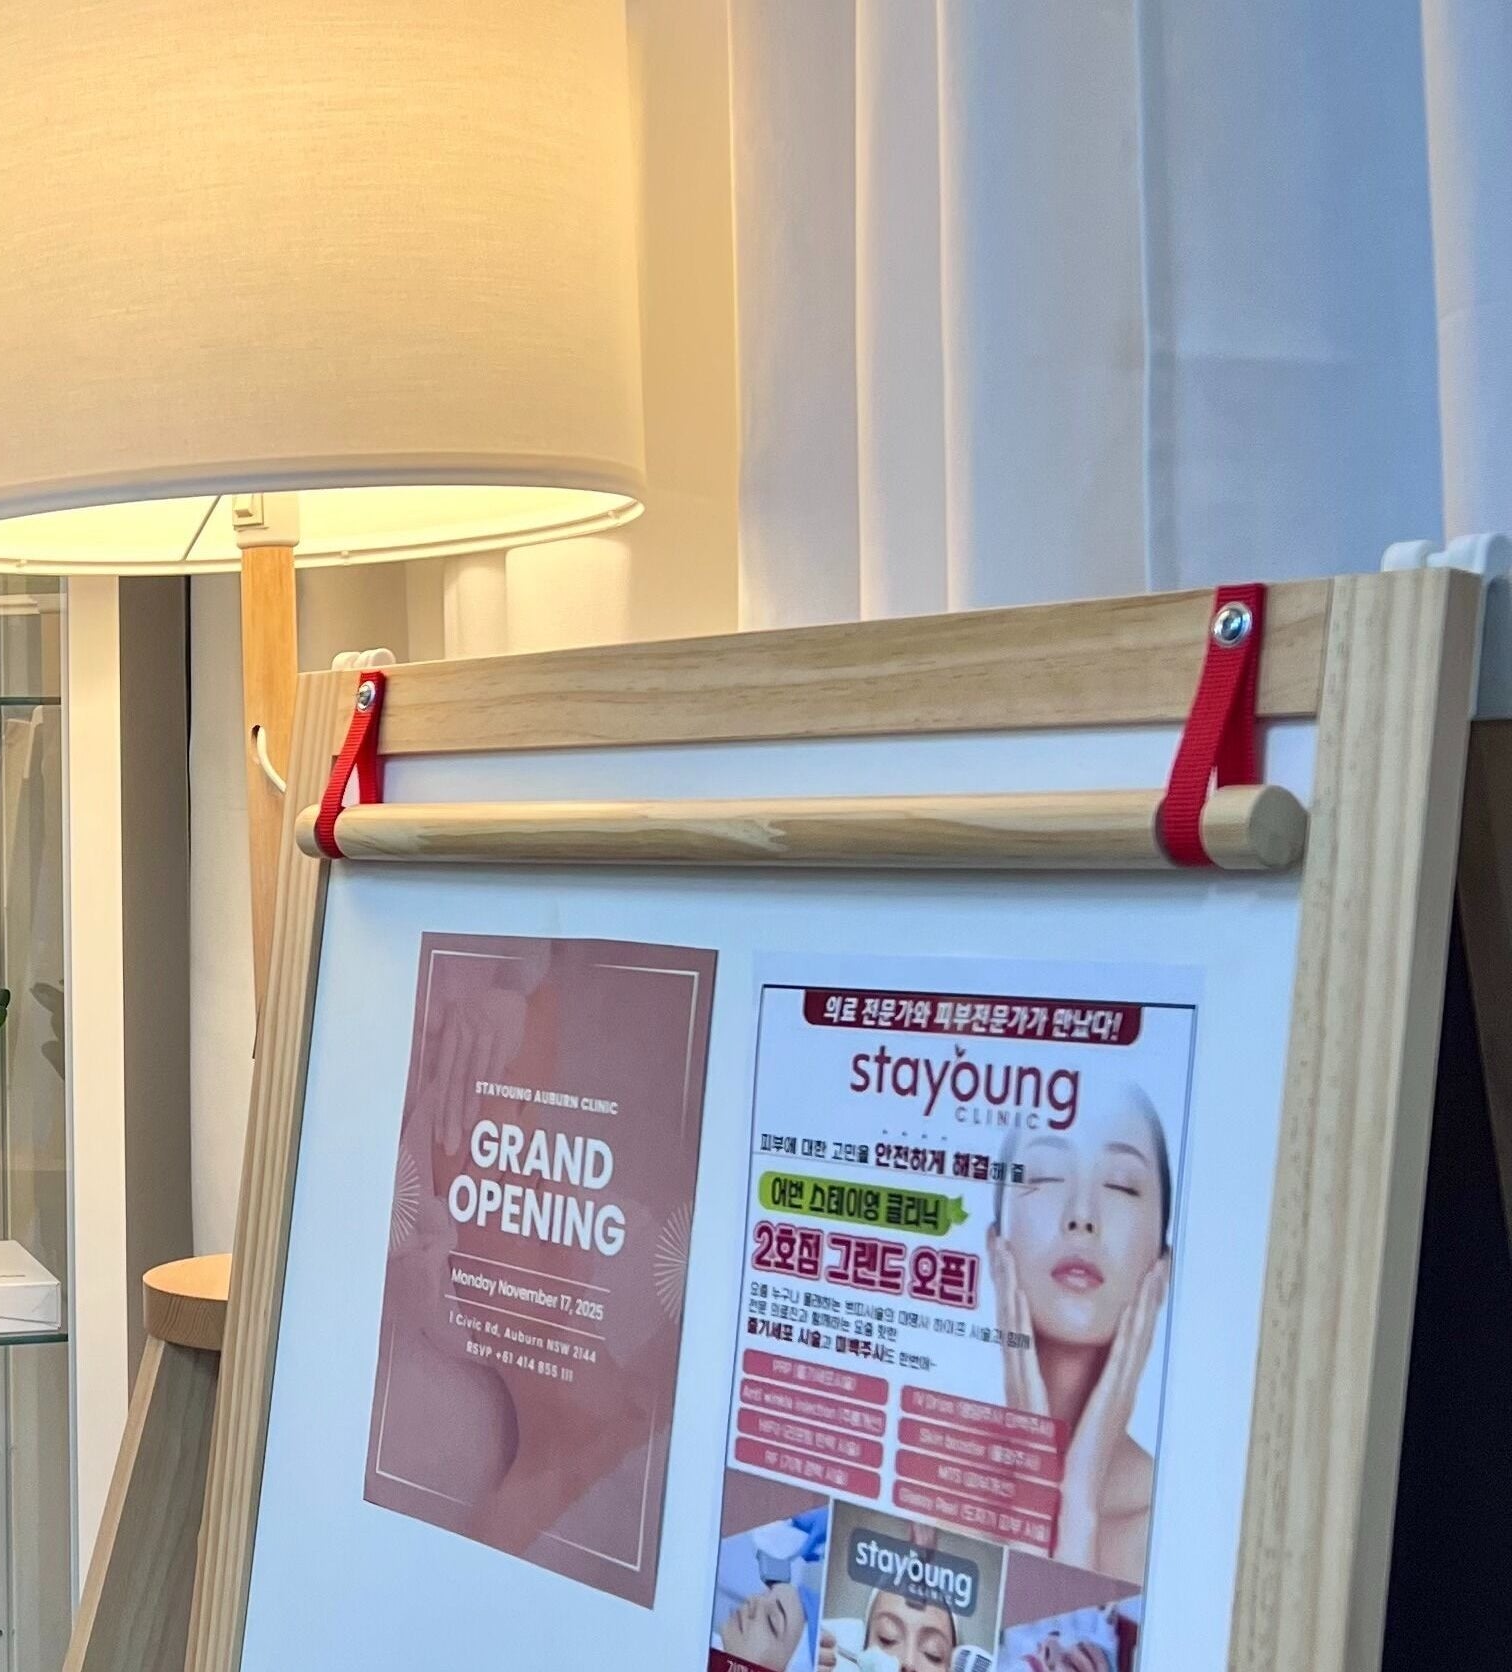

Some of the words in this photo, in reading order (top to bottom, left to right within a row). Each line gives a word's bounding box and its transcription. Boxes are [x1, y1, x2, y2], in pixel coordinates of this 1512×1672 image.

[824, 996, 859, 1023] 의료
[862, 998, 931, 1028] 전문가와
[475, 1081, 532, 1101] STAYOUNG
[534, 1090, 579, 1109] AUBURN
[580, 1098, 619, 1115] CLINIC
[850, 1045, 1080, 1130] stayoung
[955, 1107, 1040, 1129] CLINIC
[471, 1119, 614, 1190] GRAND
[875, 1142, 945, 1175] 안전하게
[448, 1174, 625, 1256] OPENING
[771, 1177, 803, 1209] 어번
[810, 1184, 881, 1221] 스테이영
[753, 1221, 823, 1278] 2호점
[910, 1247, 979, 1307] 오픈!
[451, 1267, 496, 1296] Monday
[498, 1280, 558, 1308] November
[560, 1294, 574, 1315] 17,
[576, 1299, 604, 1321] 2025
[456, 1315, 482, 1332] Civic
[504, 1327, 544, 1348] Auburn
[547, 1338, 571, 1356] NSW
[573, 1346, 597, 1363] 2144
[466, 1341, 492, 1358] RSVP
[516, 1356, 535, 1370] 414
[855, 1540, 973, 1608] stayoung
